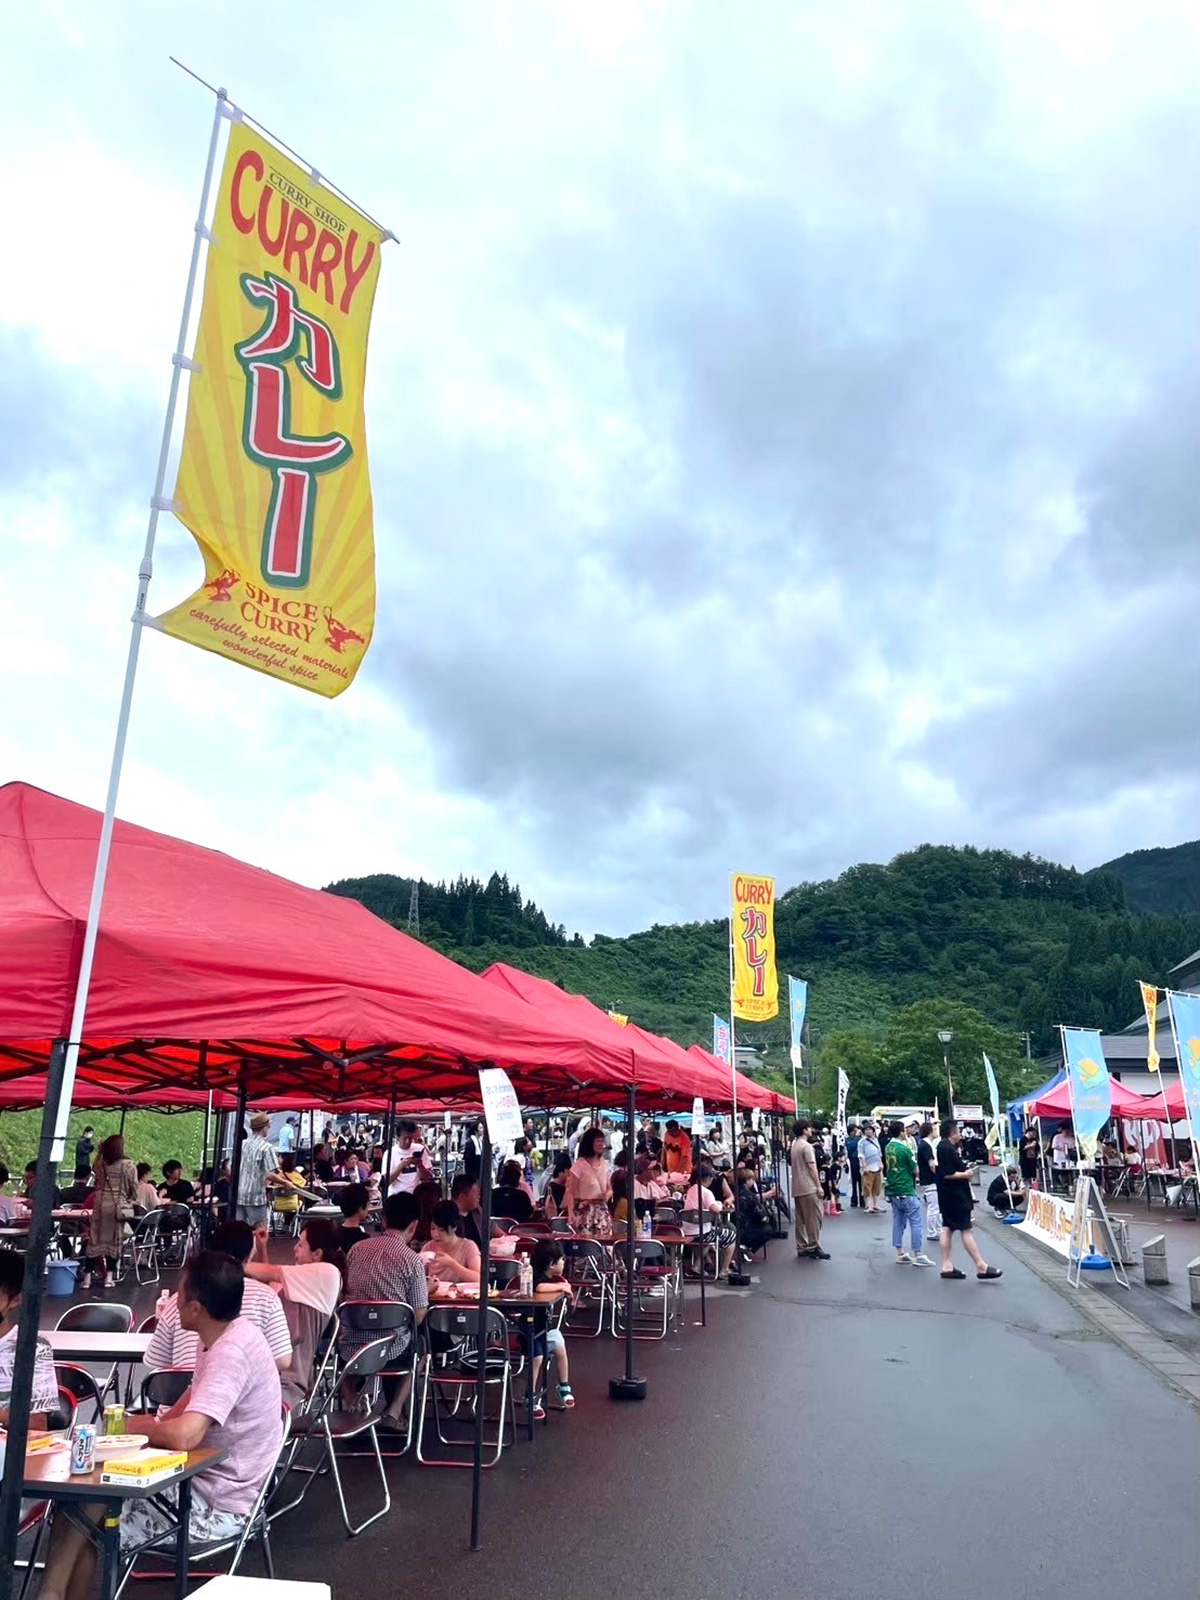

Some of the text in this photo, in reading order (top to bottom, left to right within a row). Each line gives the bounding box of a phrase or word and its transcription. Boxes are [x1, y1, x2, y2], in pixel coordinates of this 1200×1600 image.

[269, 171, 346, 234] CURRY SHOP
[230, 149, 375, 315] CURRY
[240, 601, 316, 643] CURRY
[245, 582, 318, 623] SPICE
[189, 608, 348, 679] carefully selected materials
[223, 638, 318, 681] wonderful spice
[735, 876, 772, 905] CURRY
